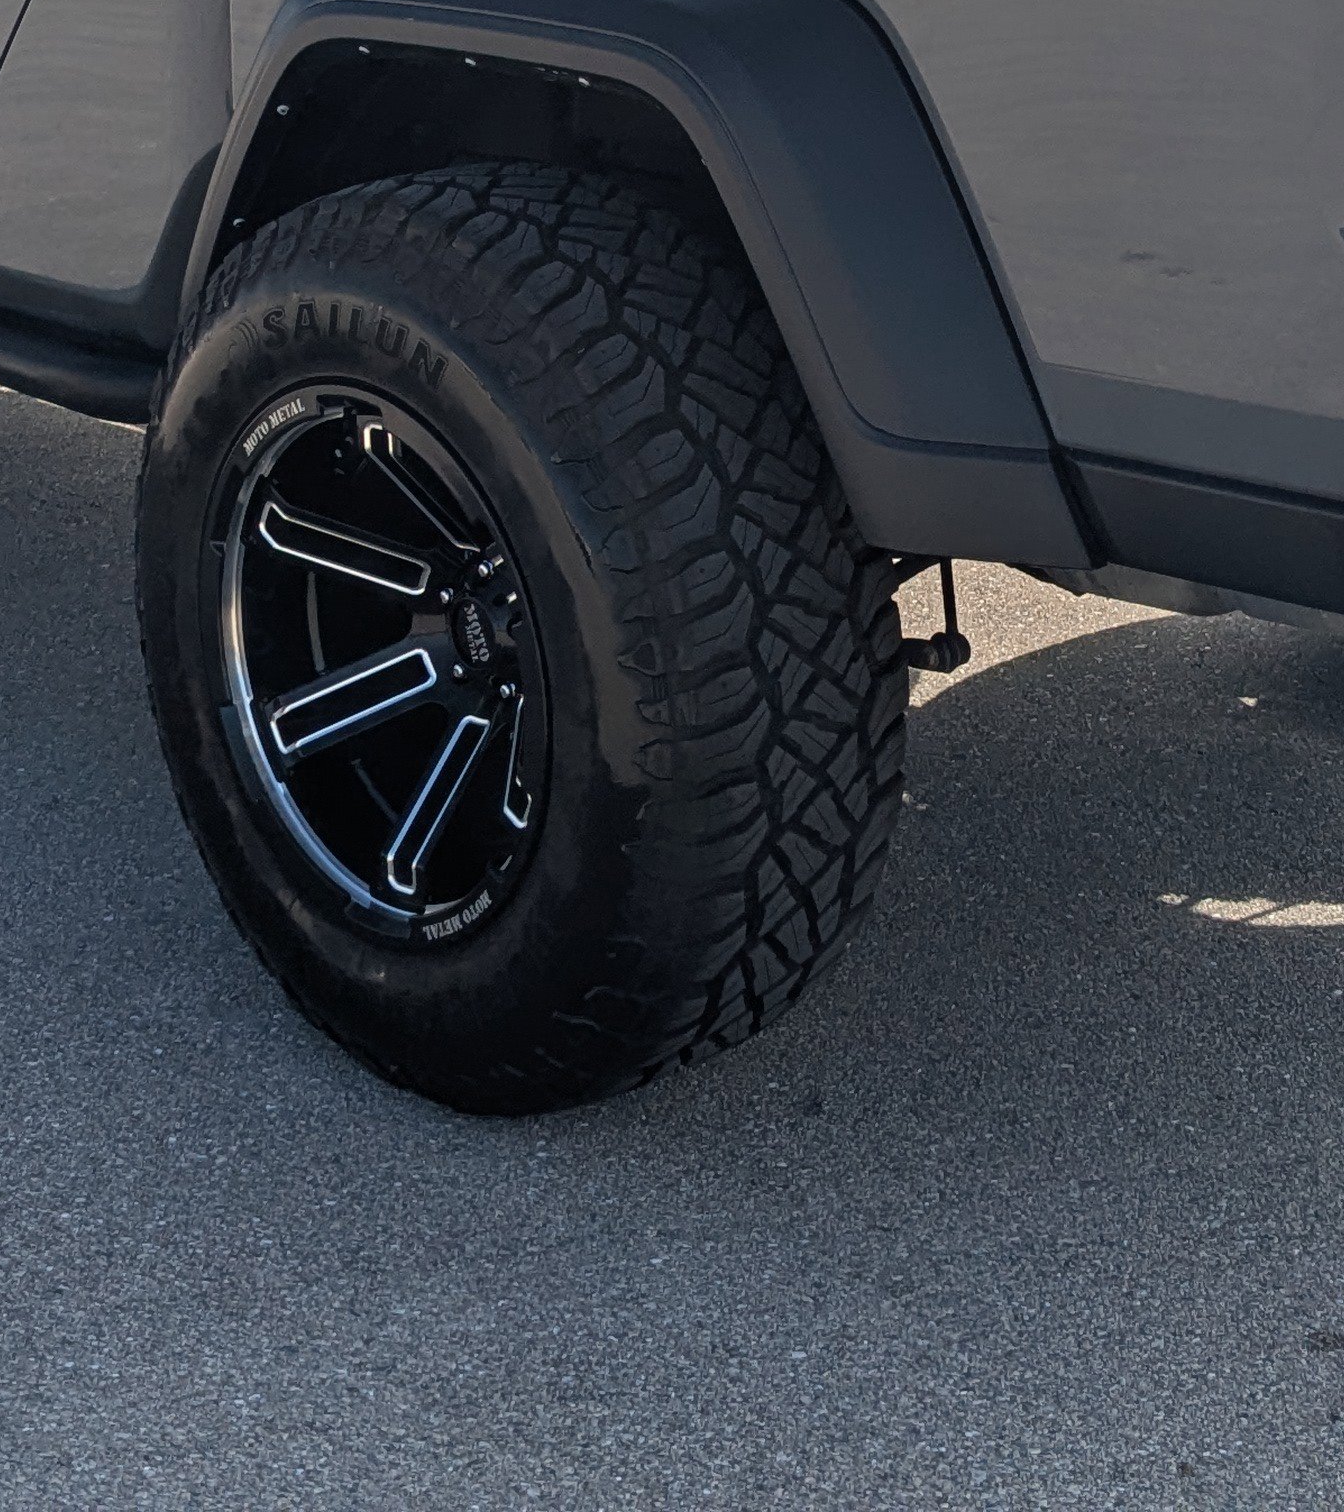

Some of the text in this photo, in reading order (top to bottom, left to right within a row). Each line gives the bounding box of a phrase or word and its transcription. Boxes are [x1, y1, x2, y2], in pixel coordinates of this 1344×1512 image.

[261, 298, 450, 392] SAILUN
[242, 398, 306, 458] MOTO METAL
[463, 602, 490, 663] MOTO
[422, 888, 493, 941] MOTO METAL
